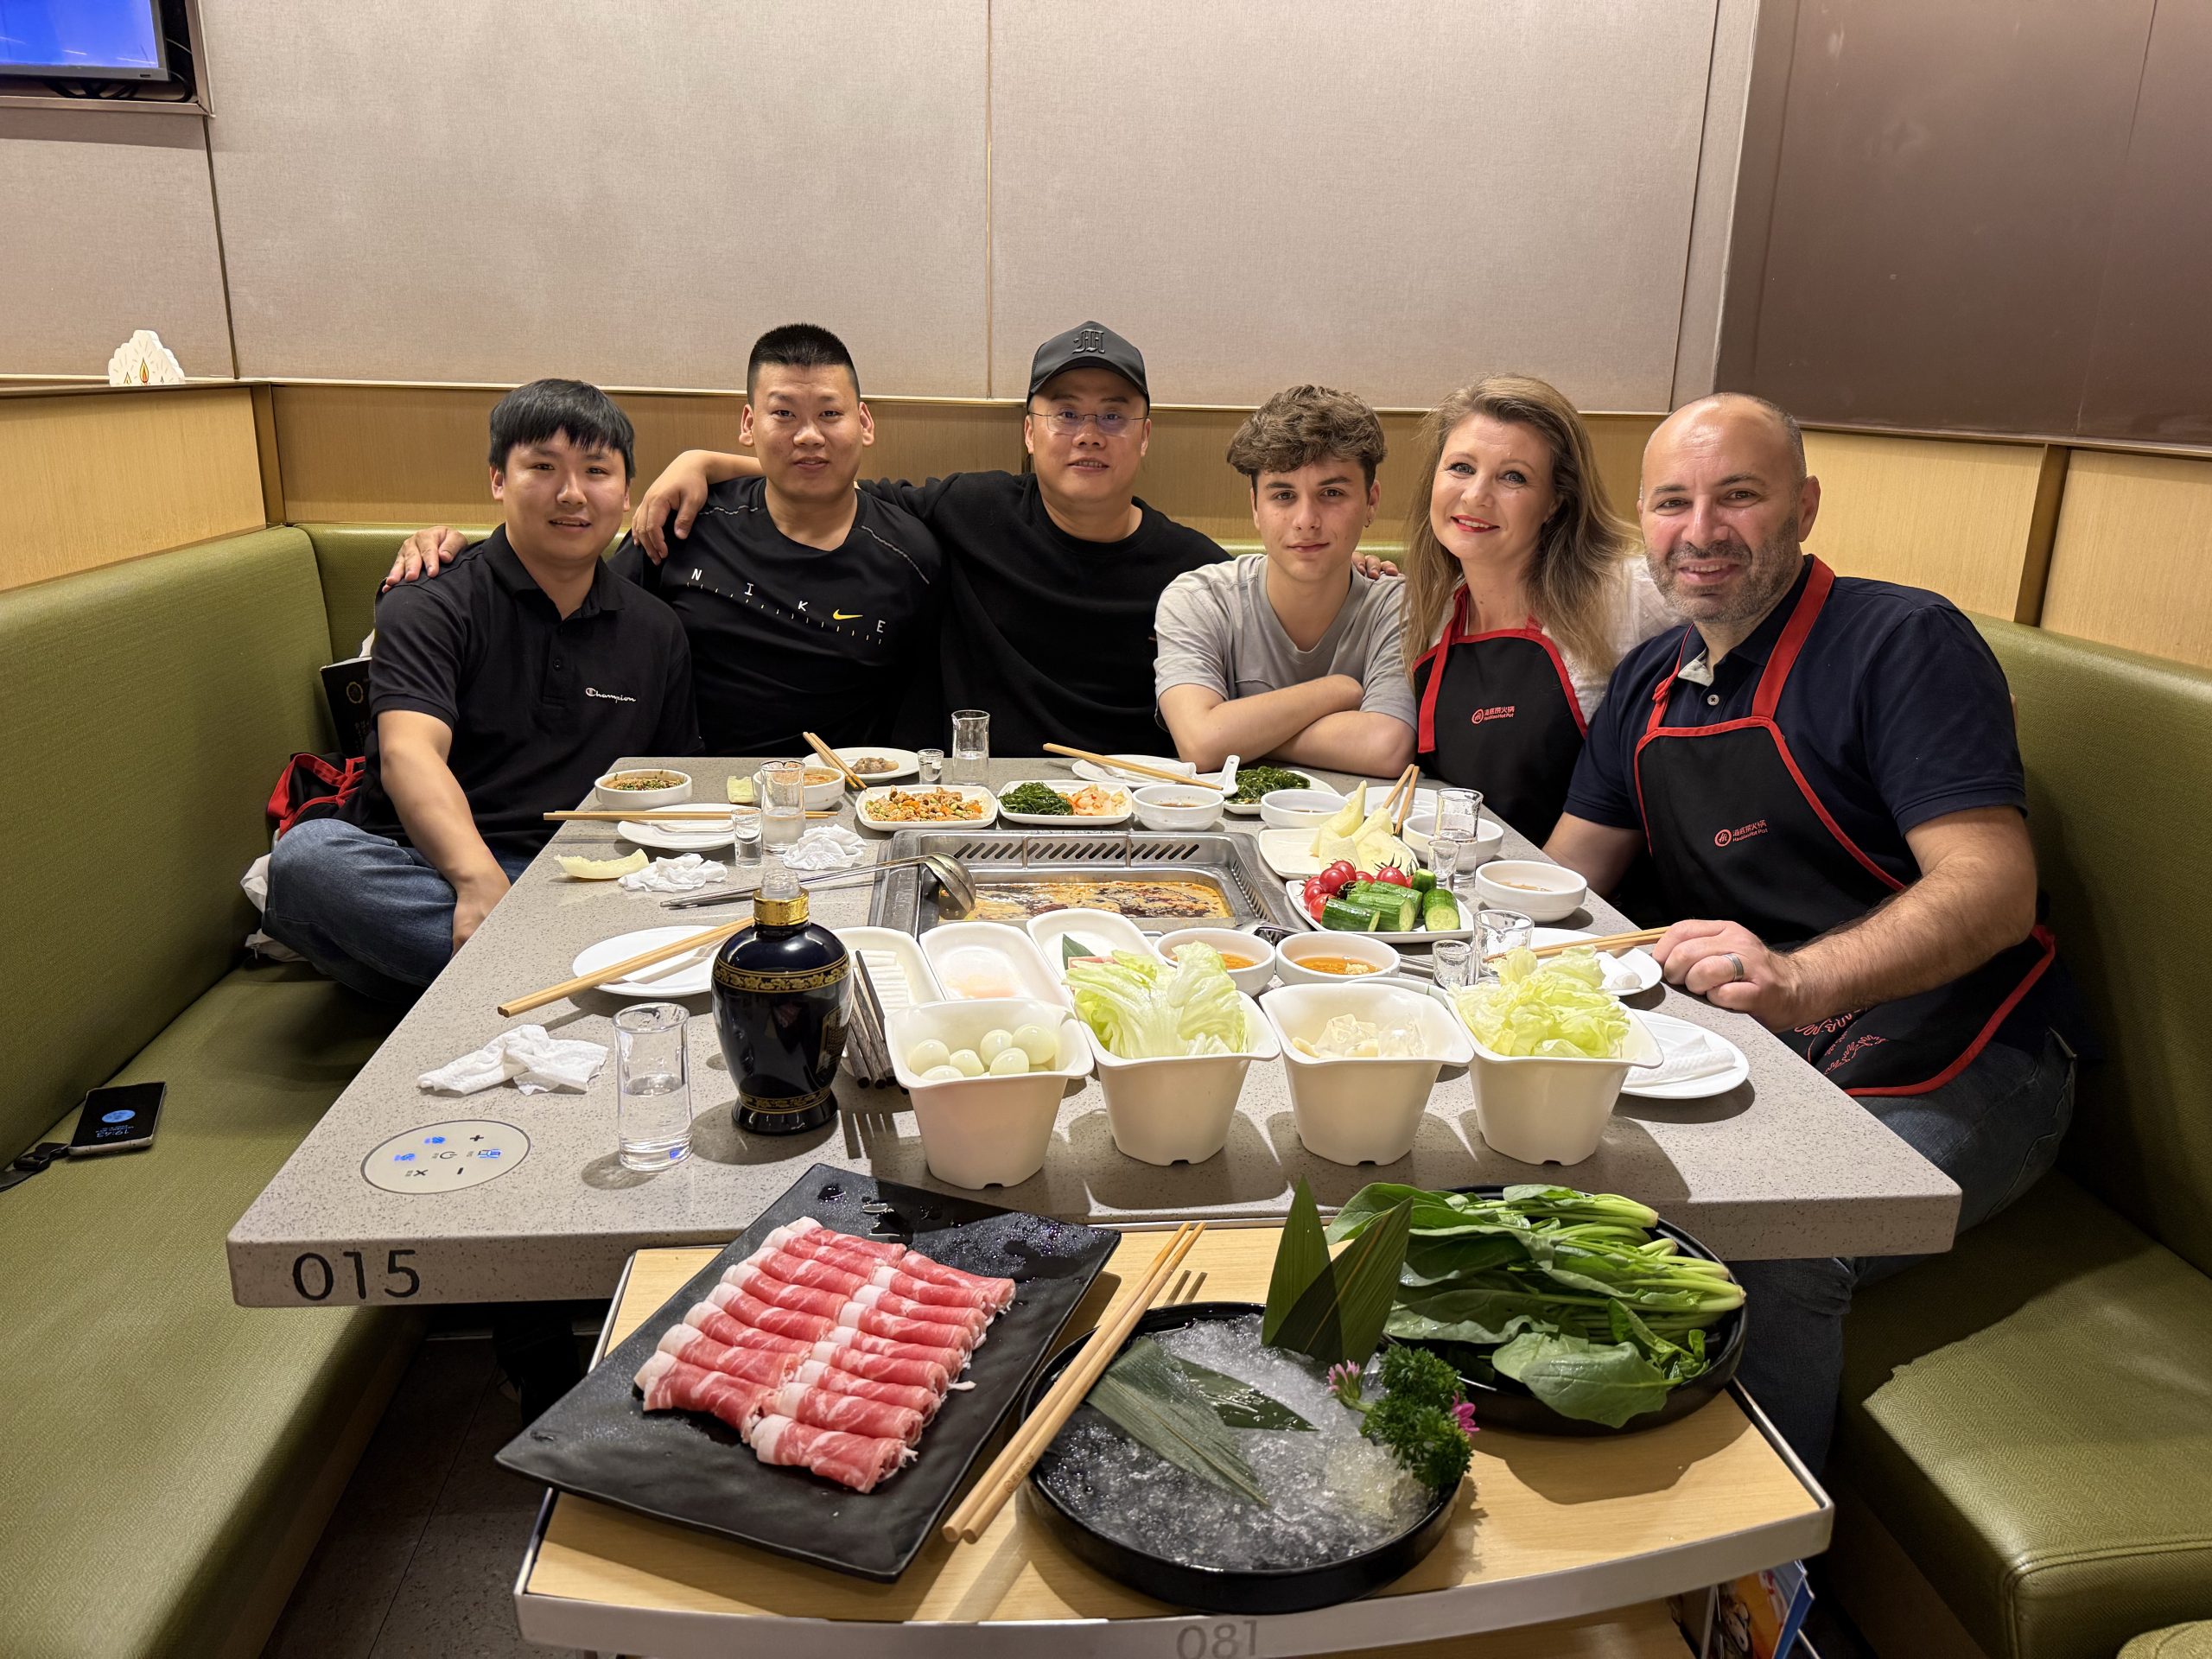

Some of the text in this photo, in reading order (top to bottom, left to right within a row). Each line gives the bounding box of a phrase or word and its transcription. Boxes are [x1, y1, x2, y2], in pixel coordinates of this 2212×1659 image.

[585, 687, 637, 703] Champion
[291, 1249, 421, 1301] 015
[1176, 1619, 1258, 1659] 081
